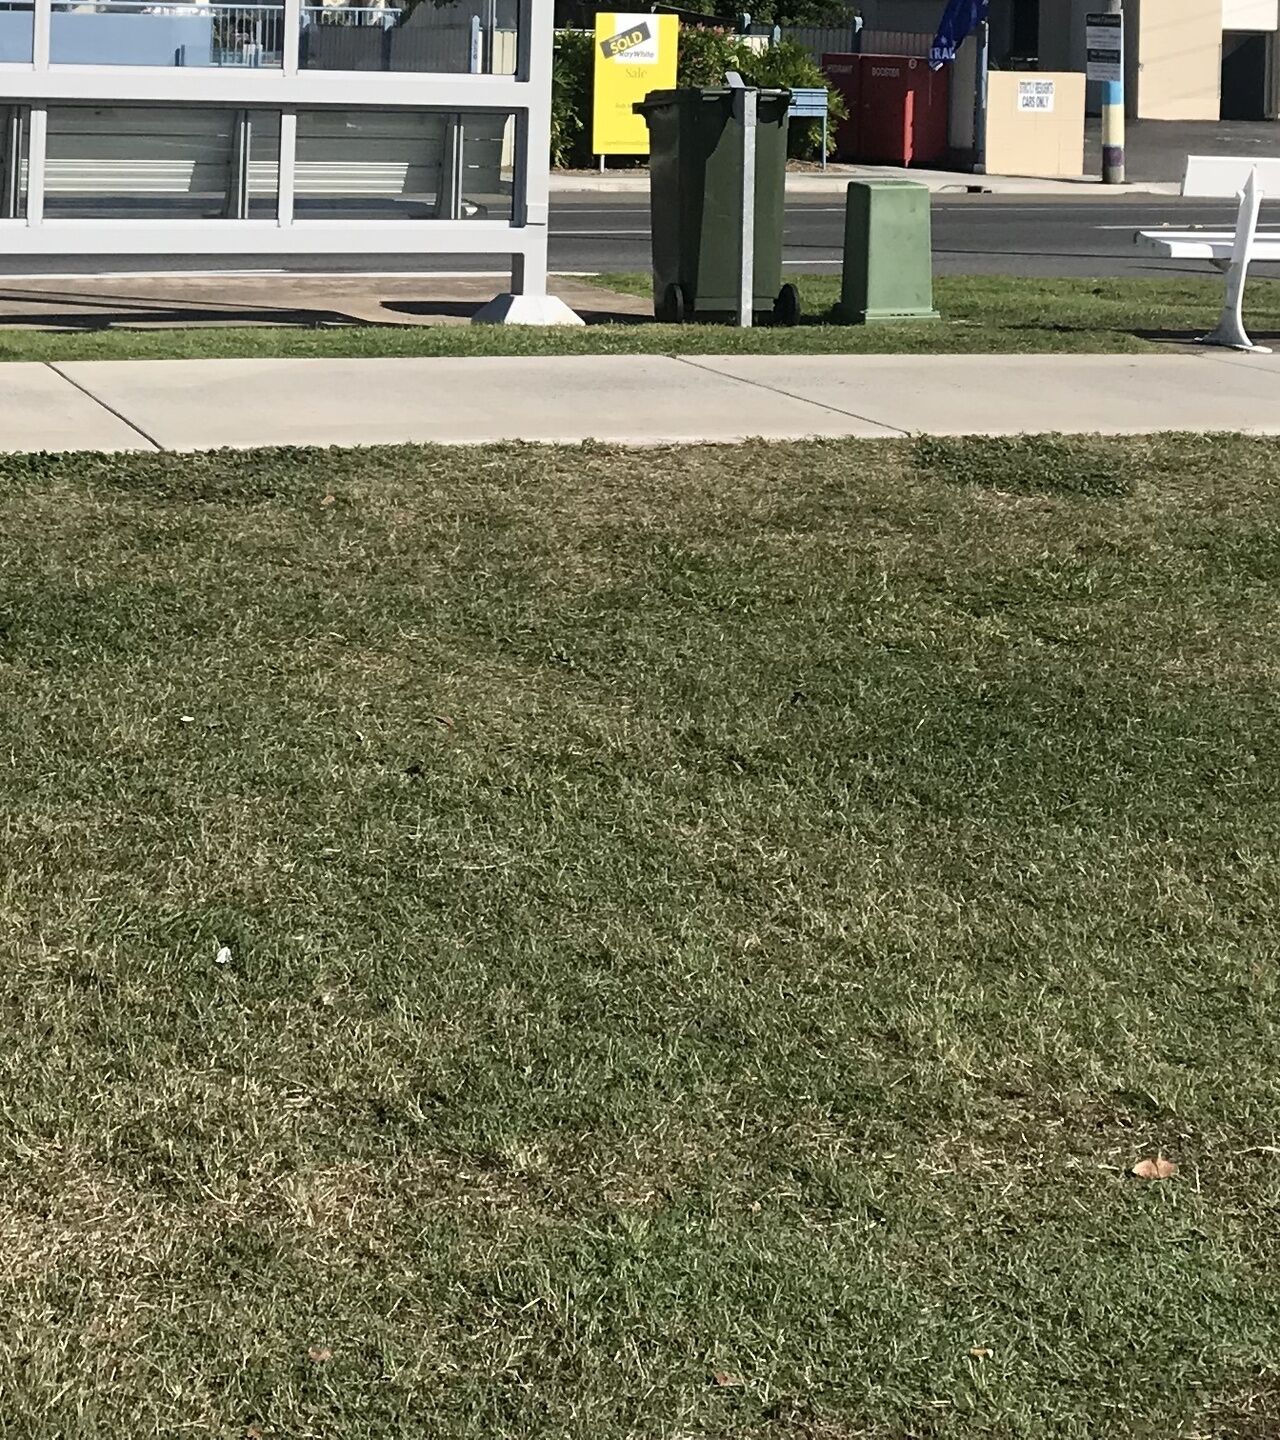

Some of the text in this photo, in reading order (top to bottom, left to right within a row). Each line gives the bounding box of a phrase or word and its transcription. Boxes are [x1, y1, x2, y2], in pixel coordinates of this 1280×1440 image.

[609, 31, 643, 54] SOLD
[871, 66, 900, 78] BOOSTER
[1022, 95, 1049, 108] CARS ONLY
